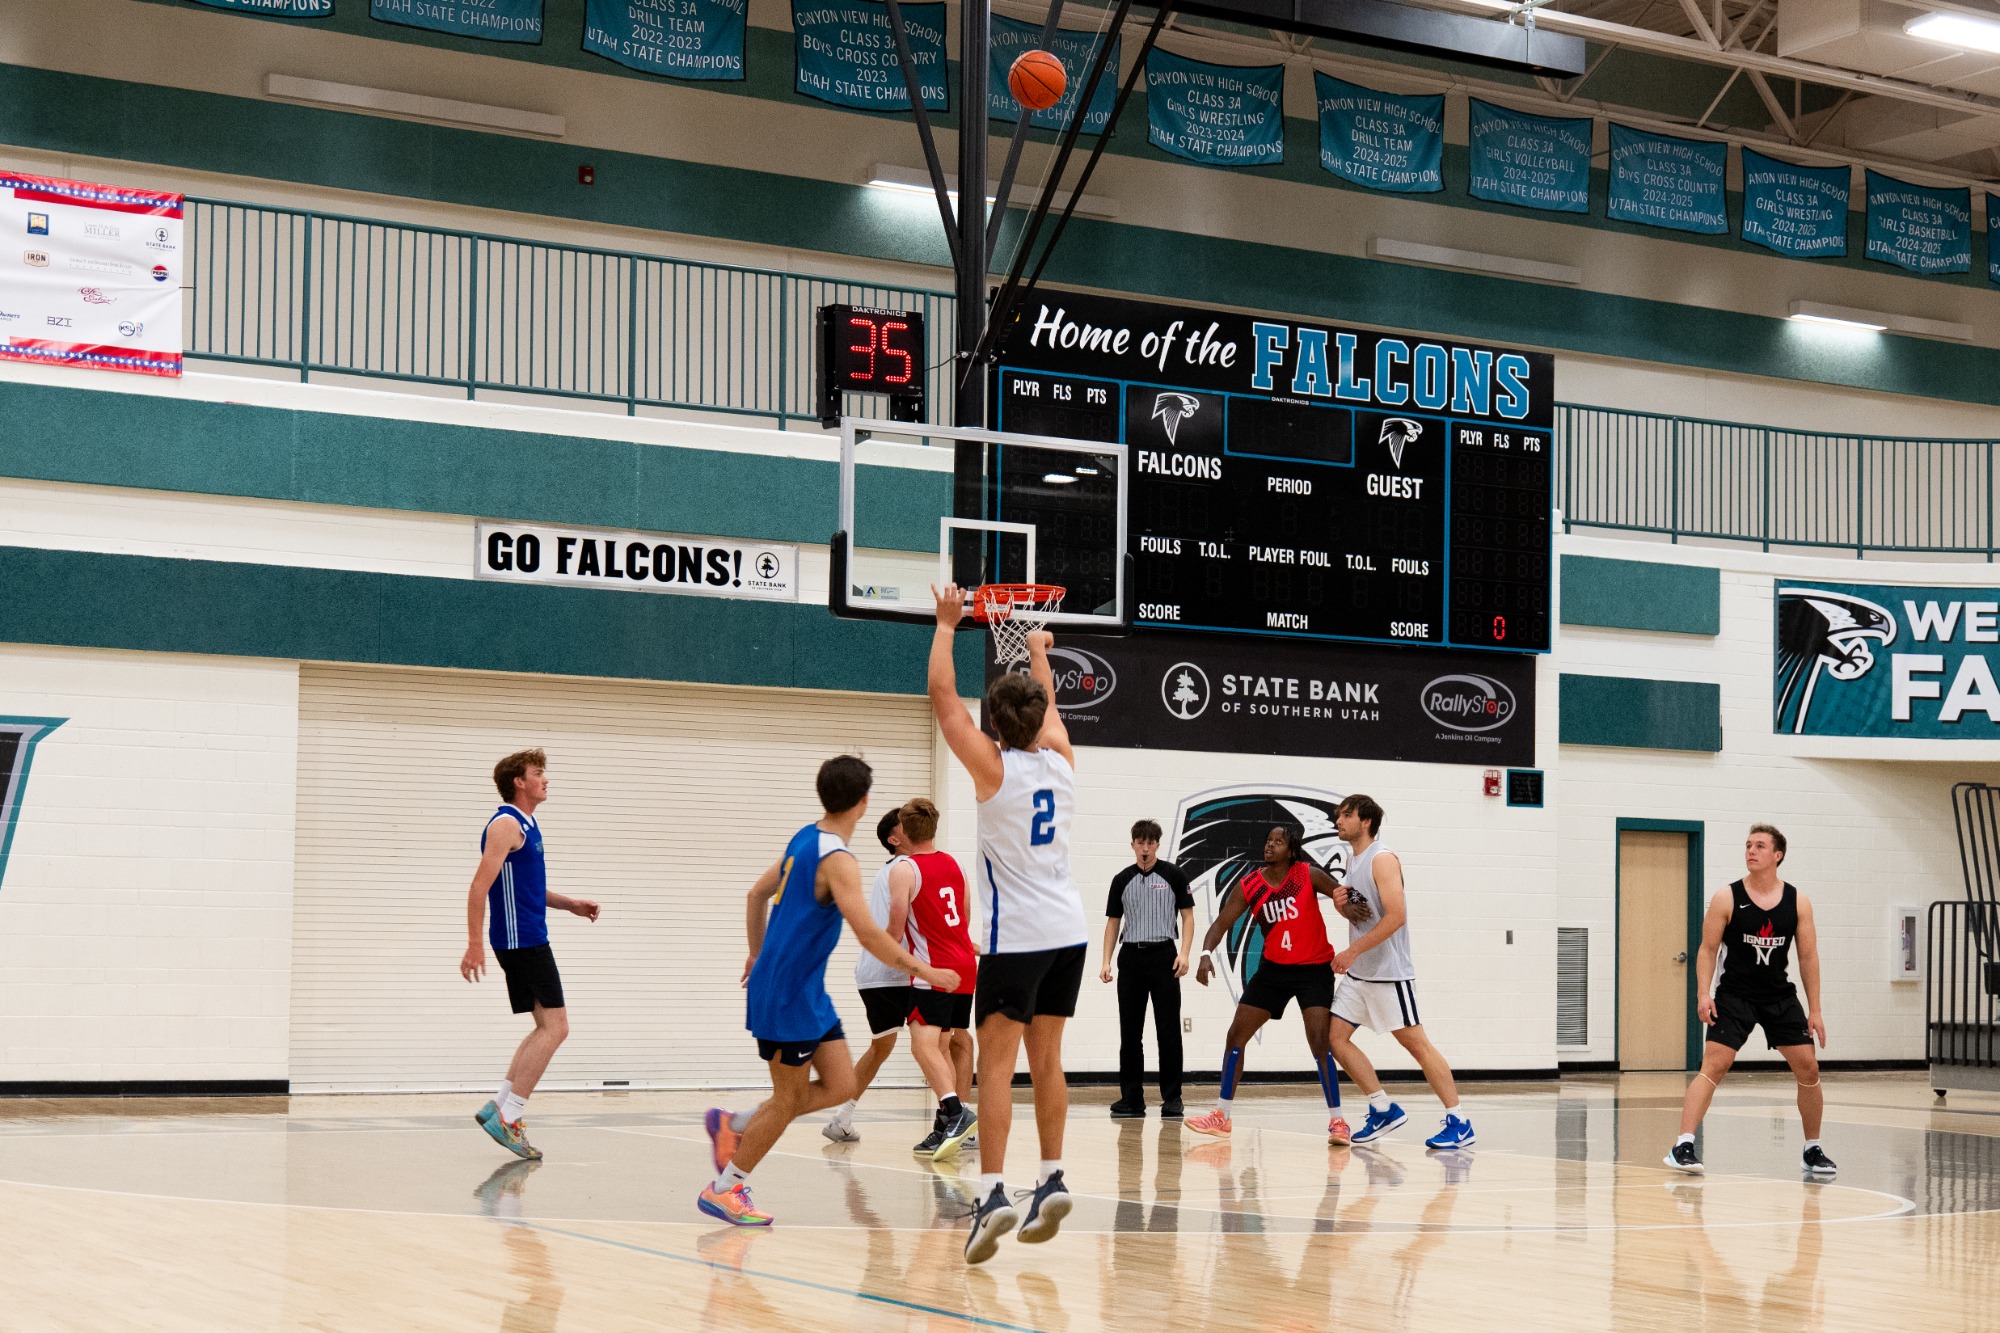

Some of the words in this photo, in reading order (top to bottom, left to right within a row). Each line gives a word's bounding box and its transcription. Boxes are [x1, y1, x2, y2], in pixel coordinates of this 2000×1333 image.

[417, 3, 455, 22] STATE
[462, 10, 541, 31] CHAMPIONS
[629, 6, 663, 28] DRILL
[668, 18, 705, 33] TEAM
[681, 2, 697, 16] 3A
[632, 24, 701, 50] 2022-2023
[840, 30, 879, 48] CLASS
[841, 11, 868, 24] VIEW
[873, 14, 892, 28] HIG
[904, 21, 942, 46] SCHOOL
[588, 27, 617, 51] UTAH
[623, 42, 662, 63] STATE
[668, 52, 740, 69] CHAMPIONS
[803, 35, 832, 57] BOYS
[837, 47, 877, 66] CROSS
[882, 51, 936, 67] CONTRY
[800, 68, 829, 90] UTAH
[835, 80, 871, 98] STATE
[876, 86, 944, 100] CHAMONS
[857, 68, 887, 83] 2023
[1149, 72, 1187, 85] CANYON
[1189, 73, 1214, 86] VIEW
[1218, 77, 1242, 92] HIGH
[1247, 84, 1278, 106] SCHOOL
[1188, 90, 1224, 108] CLASS
[1228, 97, 1241, 109] 3A
[1167, 98, 1195, 120] GIRLS
[1200, 110, 1264, 126] WRESTLING
[1357, 99, 1380, 112] VIEW
[1384, 102, 1406, 119] HIGH
[1409, 111, 1440, 133] SCHOOL
[1186, 122, 1244, 141] 2023-2024
[1356, 116, 1388, 133] CLASS
[1393, 124, 1405, 135] 3A
[1151, 124, 1174, 145] UTAH
[1179, 136, 1213, 154] STATE
[1217, 141, 1282, 157] CHAMPIONS
[1352, 129, 1380, 148] DRILL
[1384, 138, 1412, 151] TEAM
[1508, 135, 1539, 151] CLASS
[1542, 141, 1553, 153] 3A
[1534, 125, 1556, 136] HIGH
[1559, 130, 1589, 156] SCHOOL
[1321, 148, 1341, 170] UTAH
[1345, 161, 1378, 180] STATE
[1382, 170, 1438, 183] CHAMPIONS
[1353, 146, 1407, 168] 2024-2025
[1487, 147, 1510, 162] GIRLS
[1515, 153, 1575, 172] VOLLEYBALL
[1614, 143, 1644, 160] CNYON
[1649, 142, 1670, 154] VIEW
[1673, 145, 1693, 160] HIGH
[1694, 153, 1722, 176] SCHOO
[1647, 159, 1676, 174] CLASS
[1680, 165, 1691, 176] 3A
[1503, 167, 1555, 185] 2024-2025
[1644, 174, 1674, 189] CROSS
[1749, 172, 1775, 184] ANON
[1778, 173, 1796, 185] VIEW
[1800, 177, 1819, 190] HIGH
[1501, 181, 1527, 197] STATE
[1531, 187, 1588, 203] CHAMPIONS
[1643, 189, 1693, 207] 2024-2025
[1776, 189, 1804, 205] CLASS
[1807, 195, 1818, 206] 3A
[1871, 192, 1900, 205] ANYON
[1901, 193, 1920, 205] VIEW
[1923, 197, 1941, 210] HIGH
[1610, 198, 1637, 212] UTAH
[1640, 204, 1666, 218] STATE
[1670, 209, 1724, 225] CHAMPIONS
[1756, 197, 1784, 215] GIRLS
[1786, 207, 1833, 220] WRESTLING
[1902, 208, 1929, 223] CLASS
[1932, 214, 1942, 225] 3A
[1772, 218, 1816, 236] 2024-2025
[1909, 224, 1958, 241] BASKETBALL
[1766, 231, 1792, 248] STATE
[1896, 236, 1941, 255] 2024-2025
[27, 252, 46, 262] IRON
[47, 315, 73, 328] BZI
[852, 306, 907, 317] DAKTRONICS
[851, 318, 911, 383] 35
[1030, 304, 1130, 355] Home
[1141, 320, 1184, 372] of
[1185, 322, 1237, 368] the
[1252, 321, 1530, 419] FALCONS
[1013, 379, 1040, 397] PLYR
[1054, 383, 1071, 401] FLS
[1087, 387, 1107, 405] PTS
[1271, 396, 1309, 405] DAKTRONICS
[1460, 429, 1483, 446] PLYR
[1493, 433, 1510, 449] FLS
[1523, 436, 1540, 452] PTS
[1138, 450, 1222, 480] FALCONS
[1268, 476, 1312, 496] PERIOD
[1367, 473, 1423, 500] GUEST
[1140, 536, 1181, 556] FOULS
[1199, 541, 1231, 559] T.O.L.
[488, 531, 540, 573] GO
[556, 537, 742, 588] FALCONS!
[1249, 546, 1295, 565] PLAYER
[1300, 550, 1331, 568] FOUL
[1346, 554, 1377, 571] T.O.L.
[1392, 558, 1429, 576] FOULS
[1138, 603, 1181, 621] SCORE
[1266, 612, 1308, 630] MATCH
[1903, 600, 1999, 642] WE
[1390, 621, 1429, 639] SCORE
[1493, 615, 1506, 640] 0
[1222, 674, 1299, 699] STATE
[1310, 679, 1379, 704] BANK
[1222, 703, 1241, 713] OF
[1250, 703, 1333, 719] SOUTHERN
[1341, 709, 1379, 721] UTAH
[1430, 691, 1509, 719] RallyStop
[1068, 713, 1099, 722] Company
[1473, 735, 1502, 744] Company
[1031, 789, 1056, 846] 2
[938, 886, 961, 927] 3
[1262, 896, 1299, 924] UHS
[1280, 930, 1293, 951] 4
[1743, 933, 1786, 947] IGNITED
